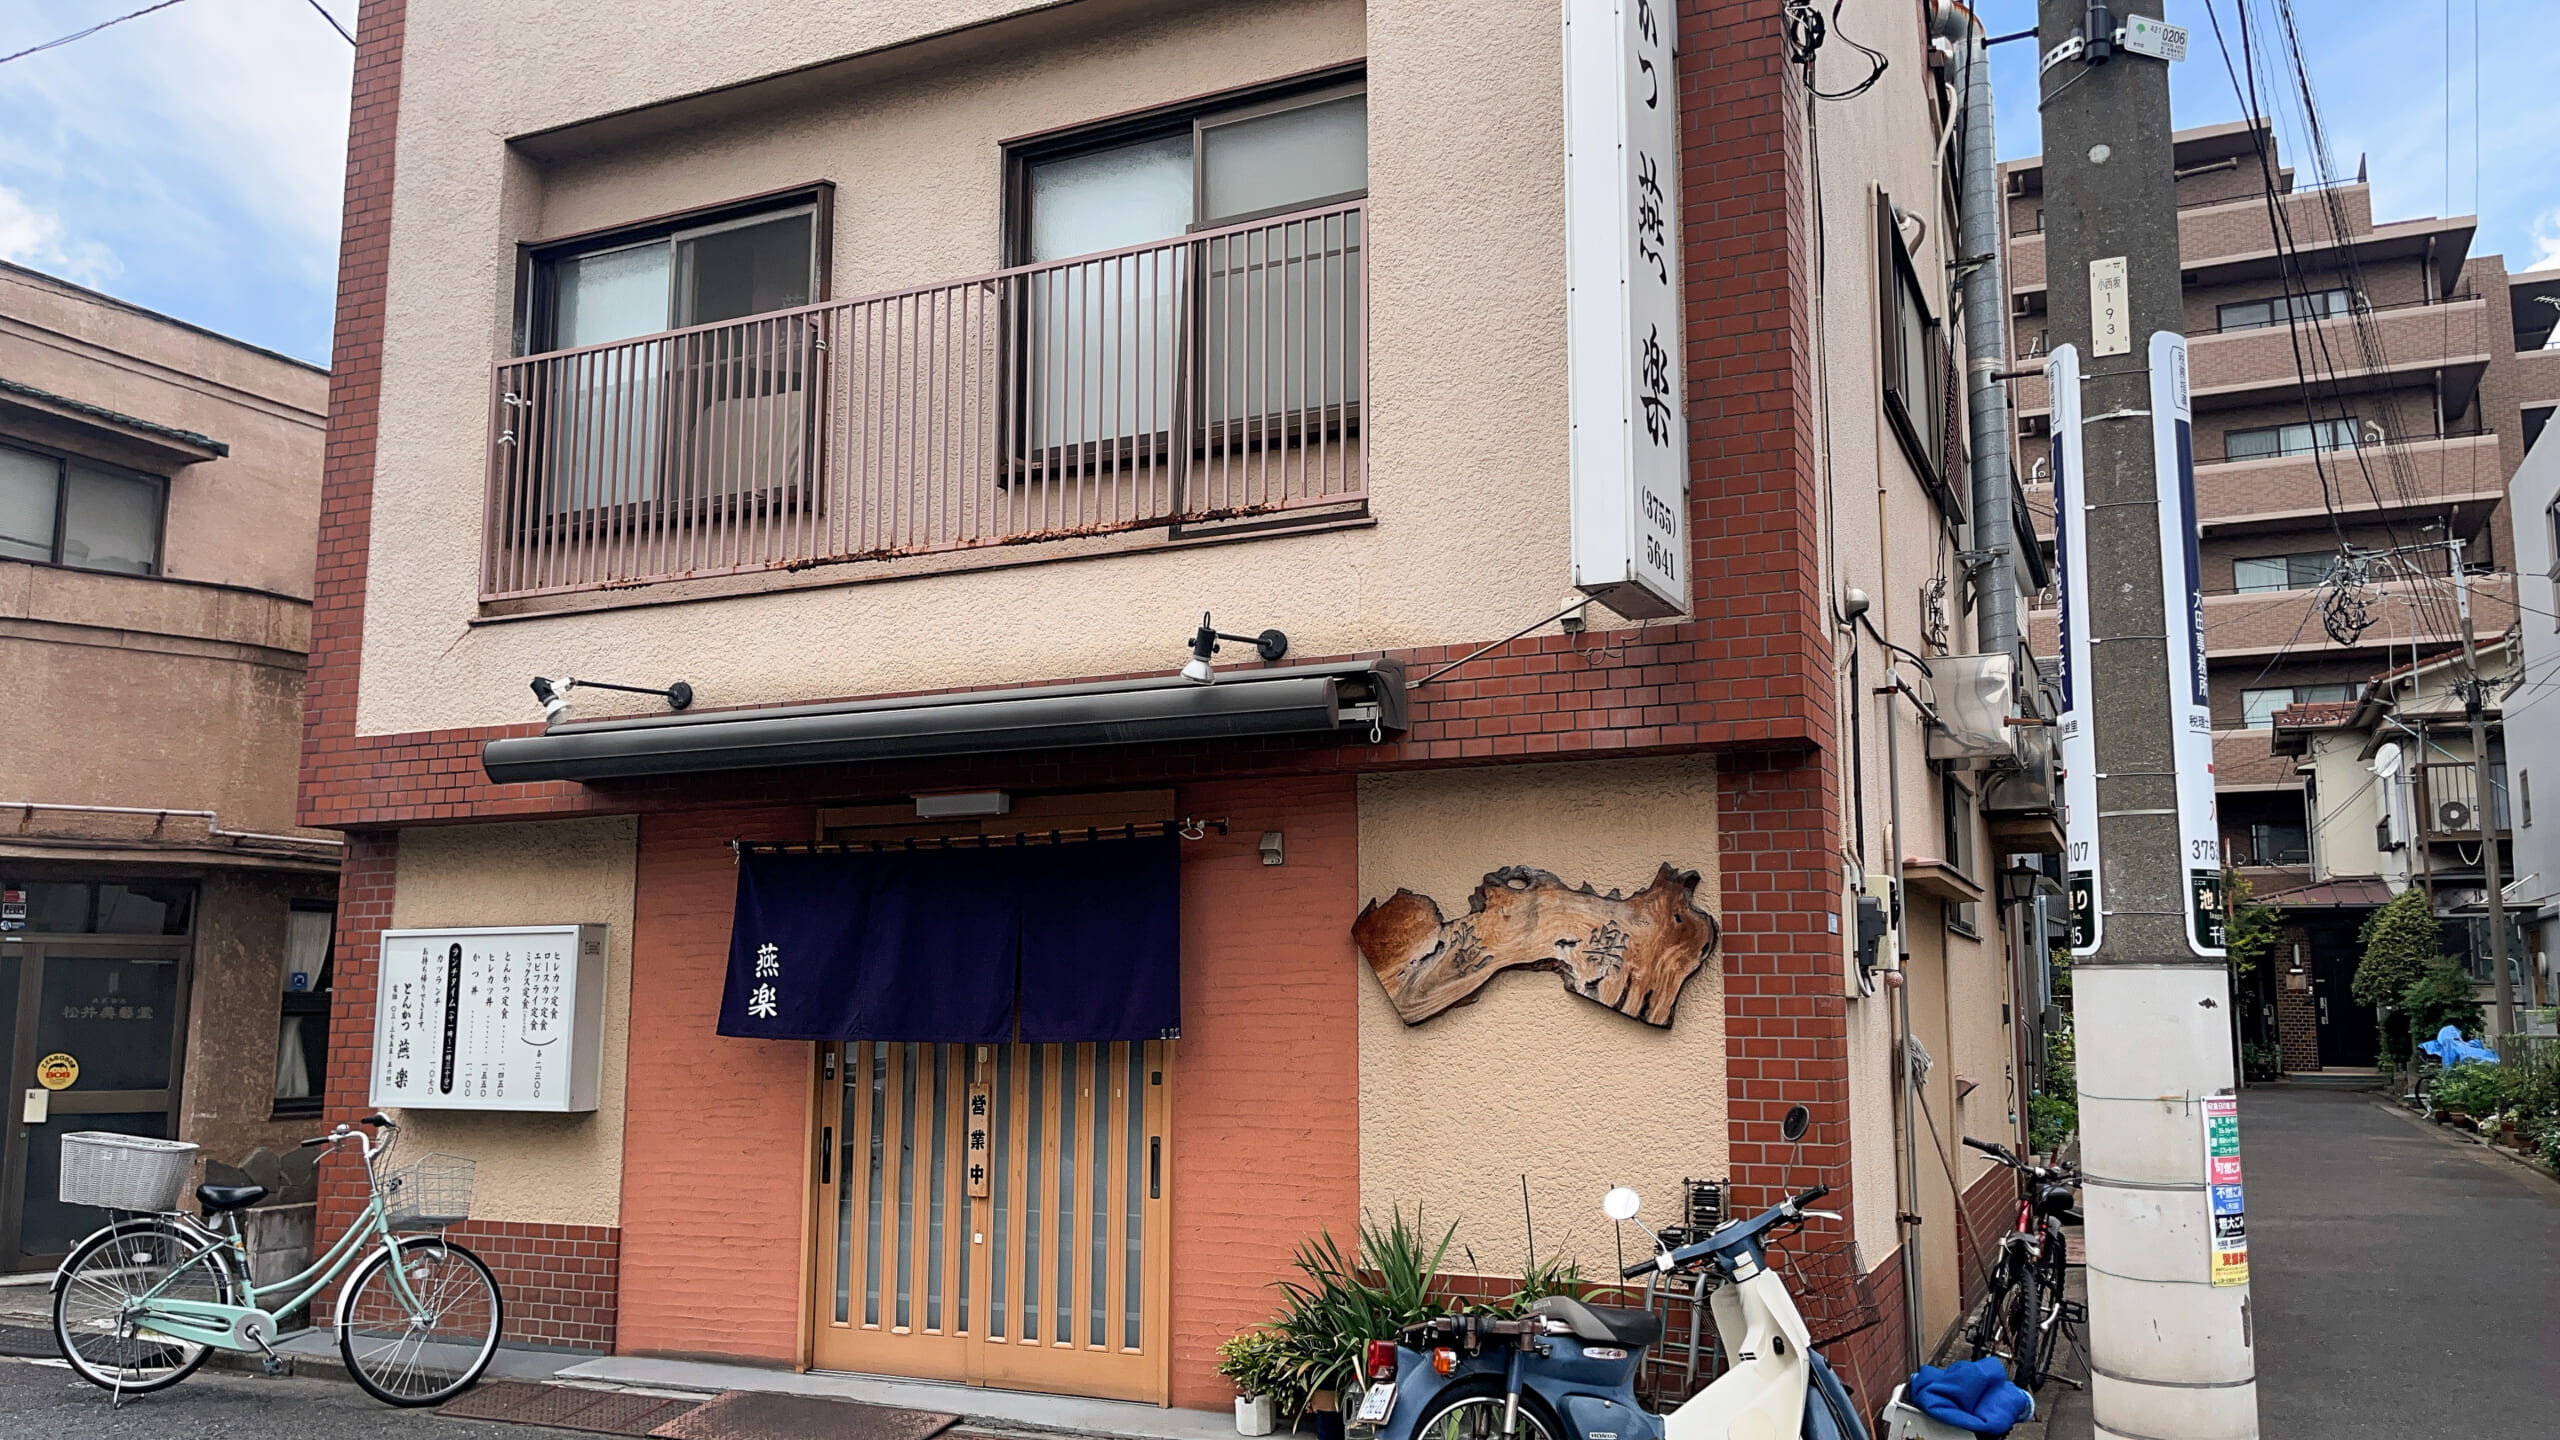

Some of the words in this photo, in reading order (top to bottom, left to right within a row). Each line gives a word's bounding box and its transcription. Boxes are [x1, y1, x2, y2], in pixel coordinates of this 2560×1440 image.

[2162, 28, 2186, 45] 0206
[1642, 485, 1676, 539] (3755)
[1646, 534, 1675, 581] 5641
[401, 982, 412, 1031] とんかつ
[434, 954, 444, 1007] カツランチ
[501, 951, 511, 1020] とんかつ定食
[530, 952, 542, 1031] エビフライ定食
[540, 952, 551, 1031] ロースカツ定食
[550, 951, 561, 1020] ヒレカツ定食
[747, 942, 780, 1019] 燕楽
[970, 1094, 987, 1185] 営業中
